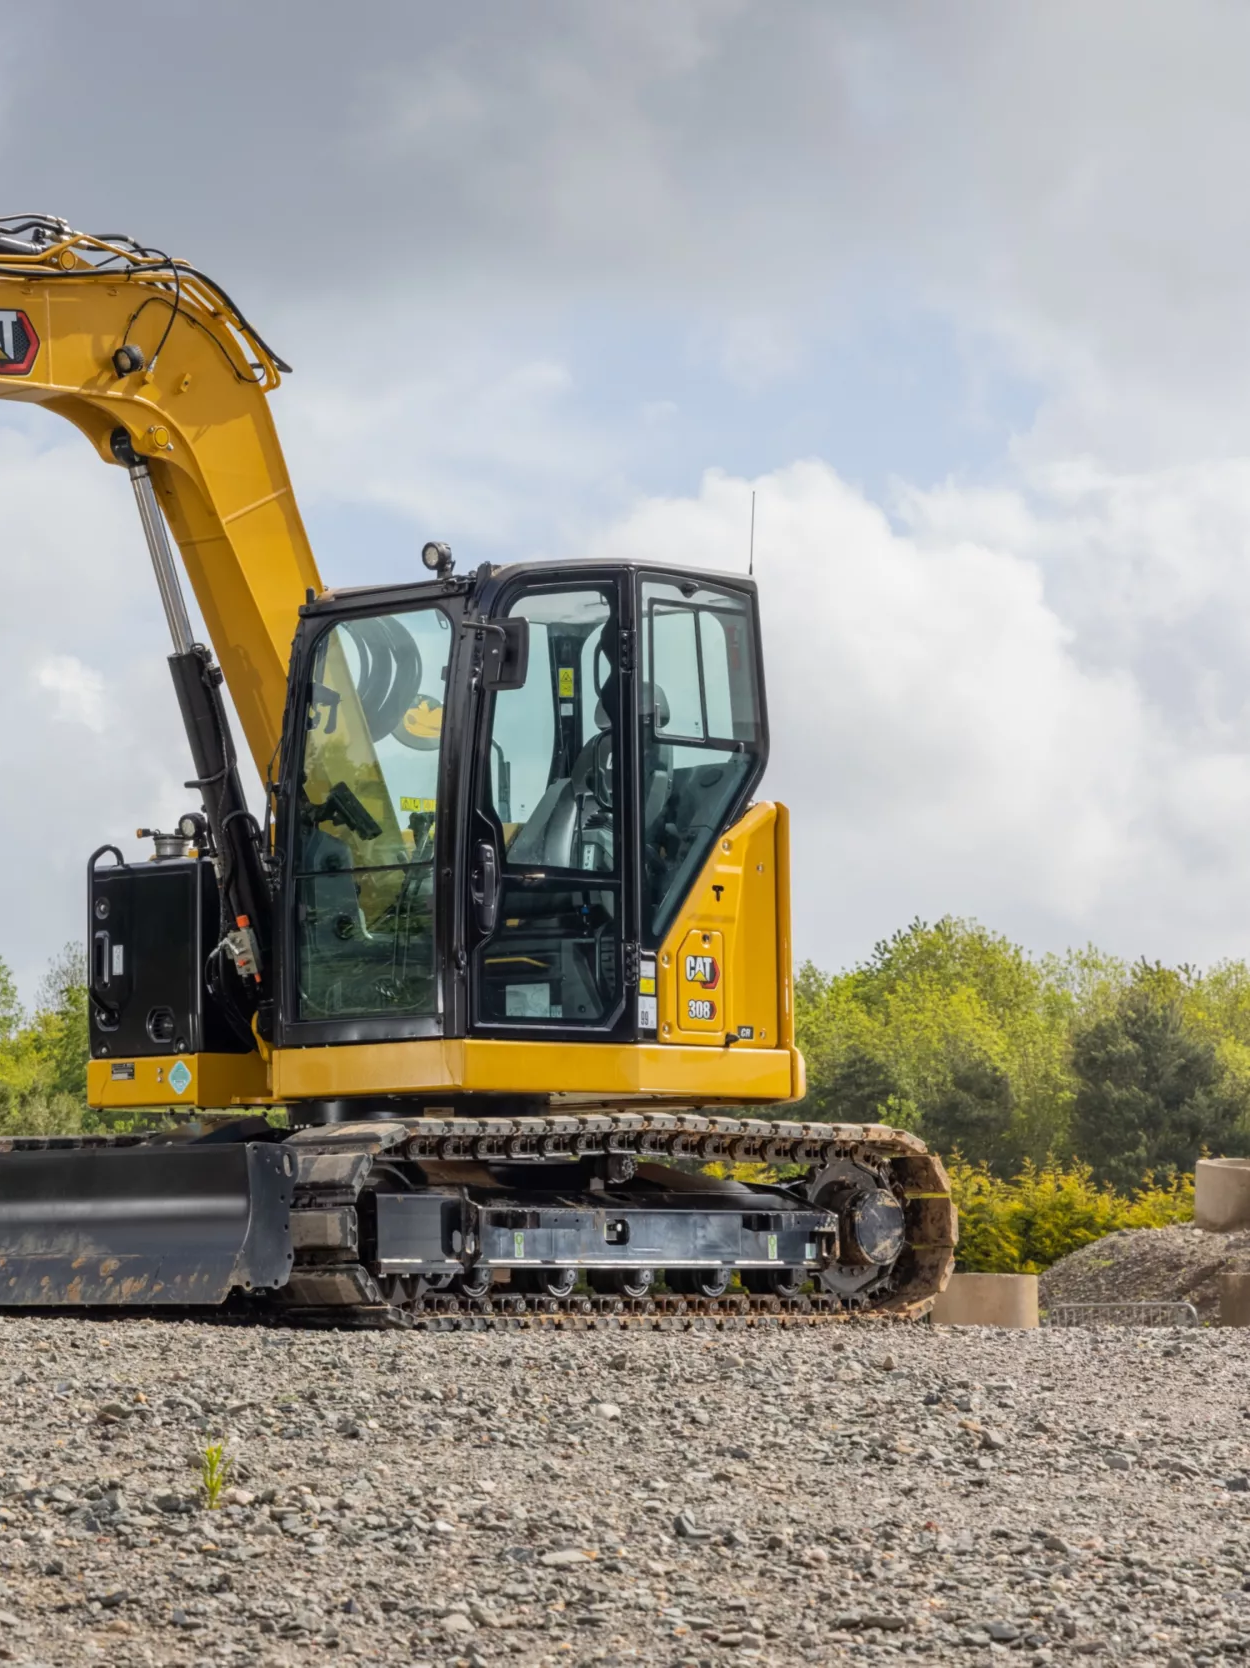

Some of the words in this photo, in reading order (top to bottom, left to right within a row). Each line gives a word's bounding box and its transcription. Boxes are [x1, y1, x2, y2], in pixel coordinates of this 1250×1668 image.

[686, 955, 713, 981] CAT
[689, 999, 711, 1019] 308
[740, 1027, 752, 1038] CR
